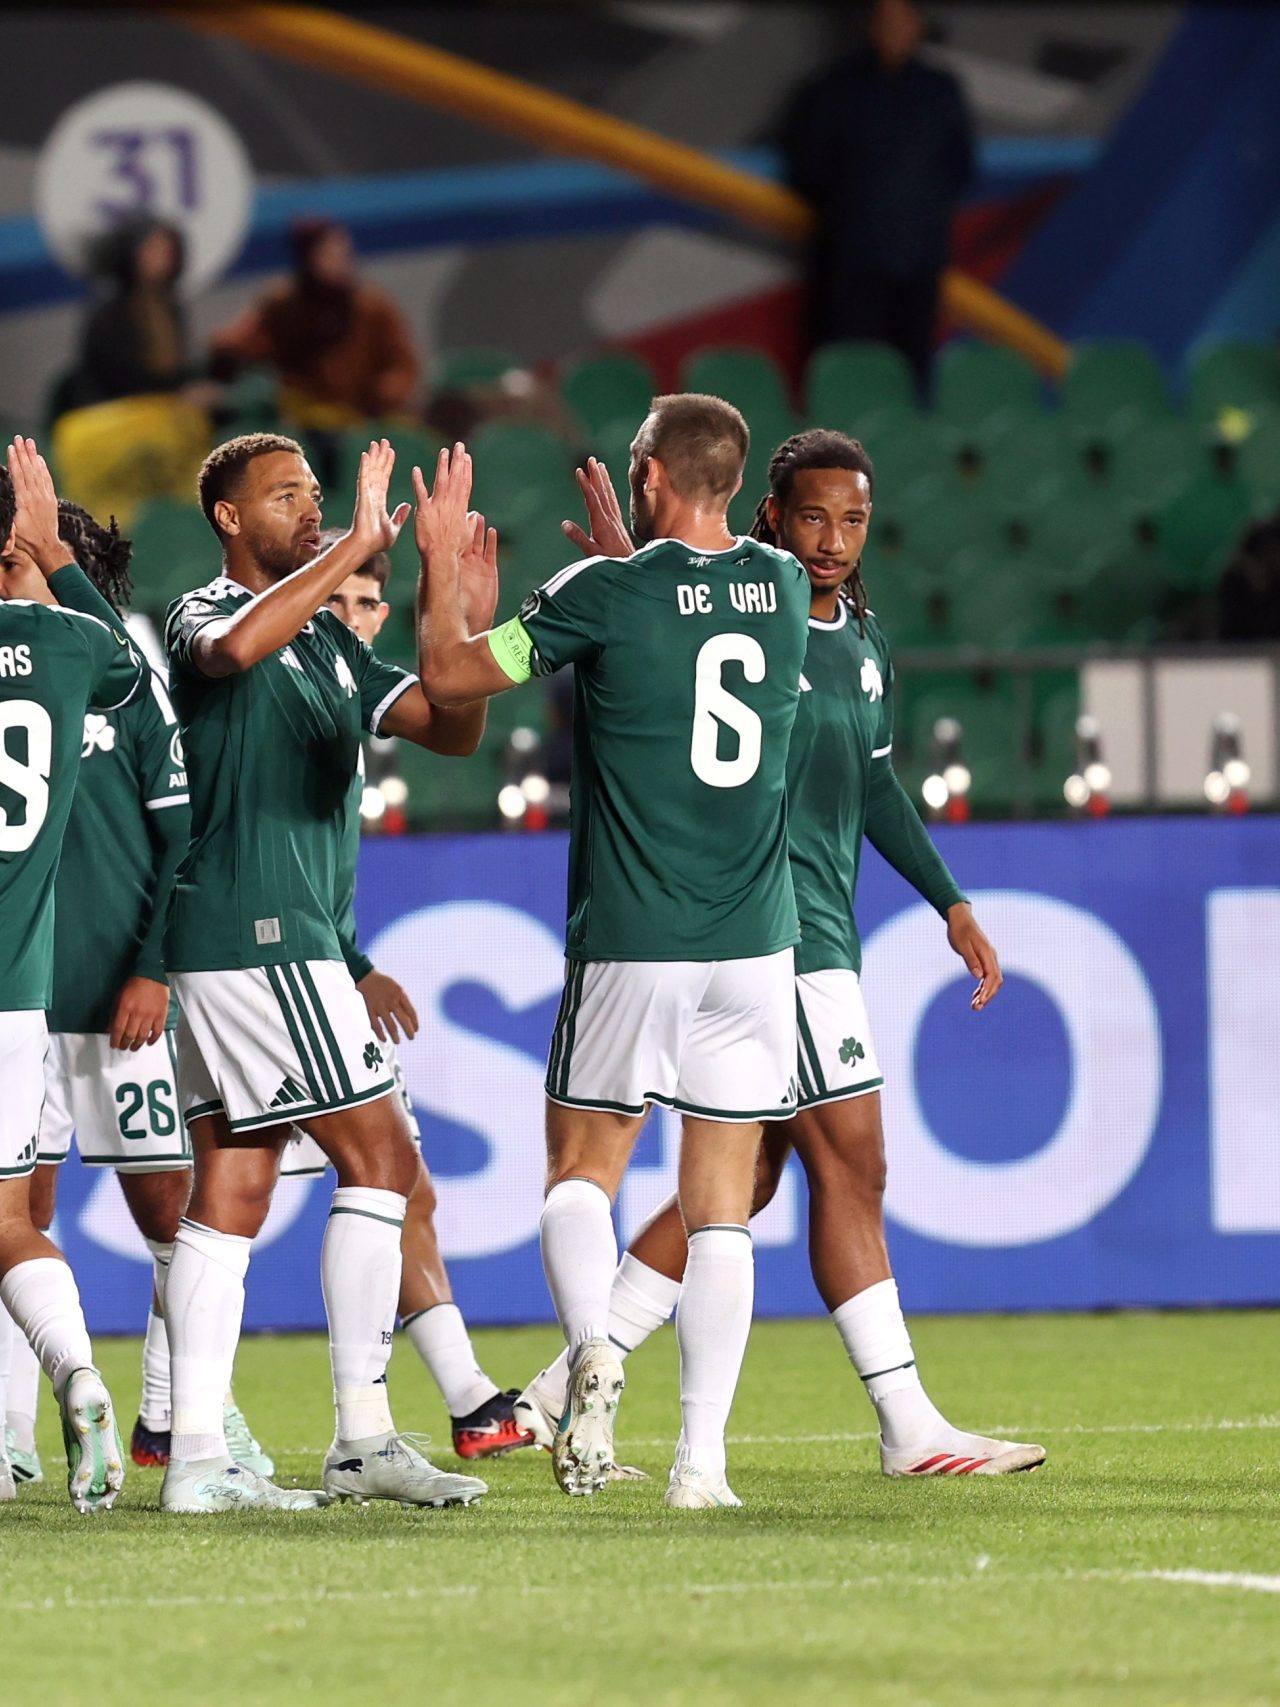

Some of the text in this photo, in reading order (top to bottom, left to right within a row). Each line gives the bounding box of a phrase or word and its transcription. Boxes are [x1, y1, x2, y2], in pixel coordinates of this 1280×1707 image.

[92, 126, 199, 222] 31
[677, 583, 713, 616] DE
[691, 632, 766, 788] 6
[115, 1079, 176, 1140] 26
